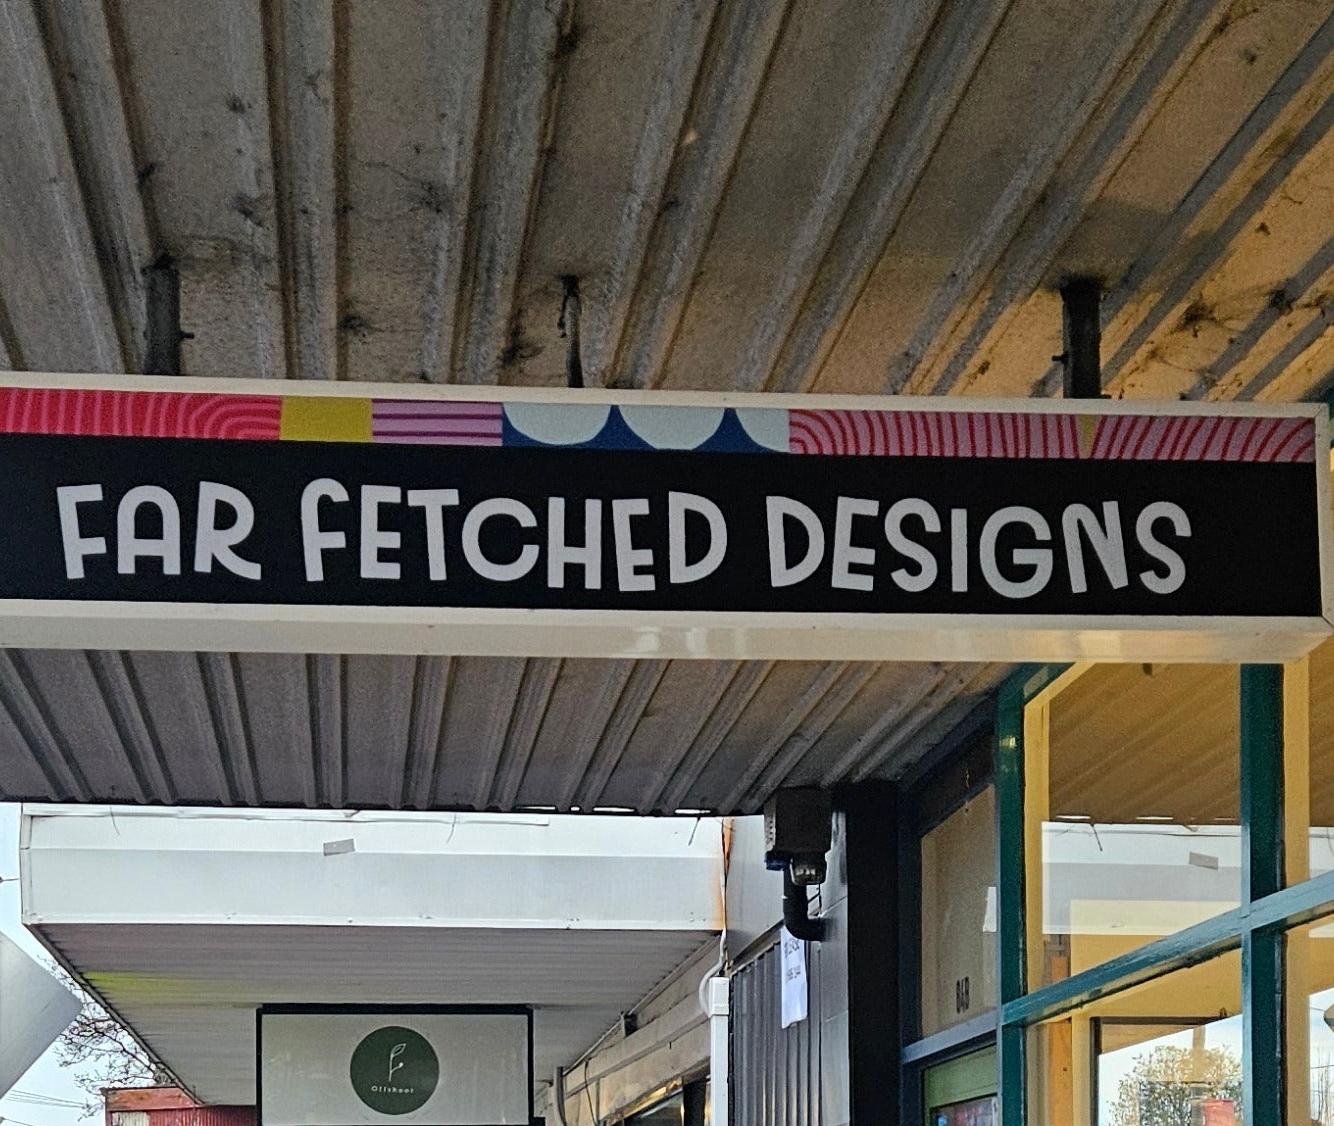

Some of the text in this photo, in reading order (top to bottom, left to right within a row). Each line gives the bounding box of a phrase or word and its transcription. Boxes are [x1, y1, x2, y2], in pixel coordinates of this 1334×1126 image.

[56, 477, 1193, 598] FAR FETCHED DESIGNS
